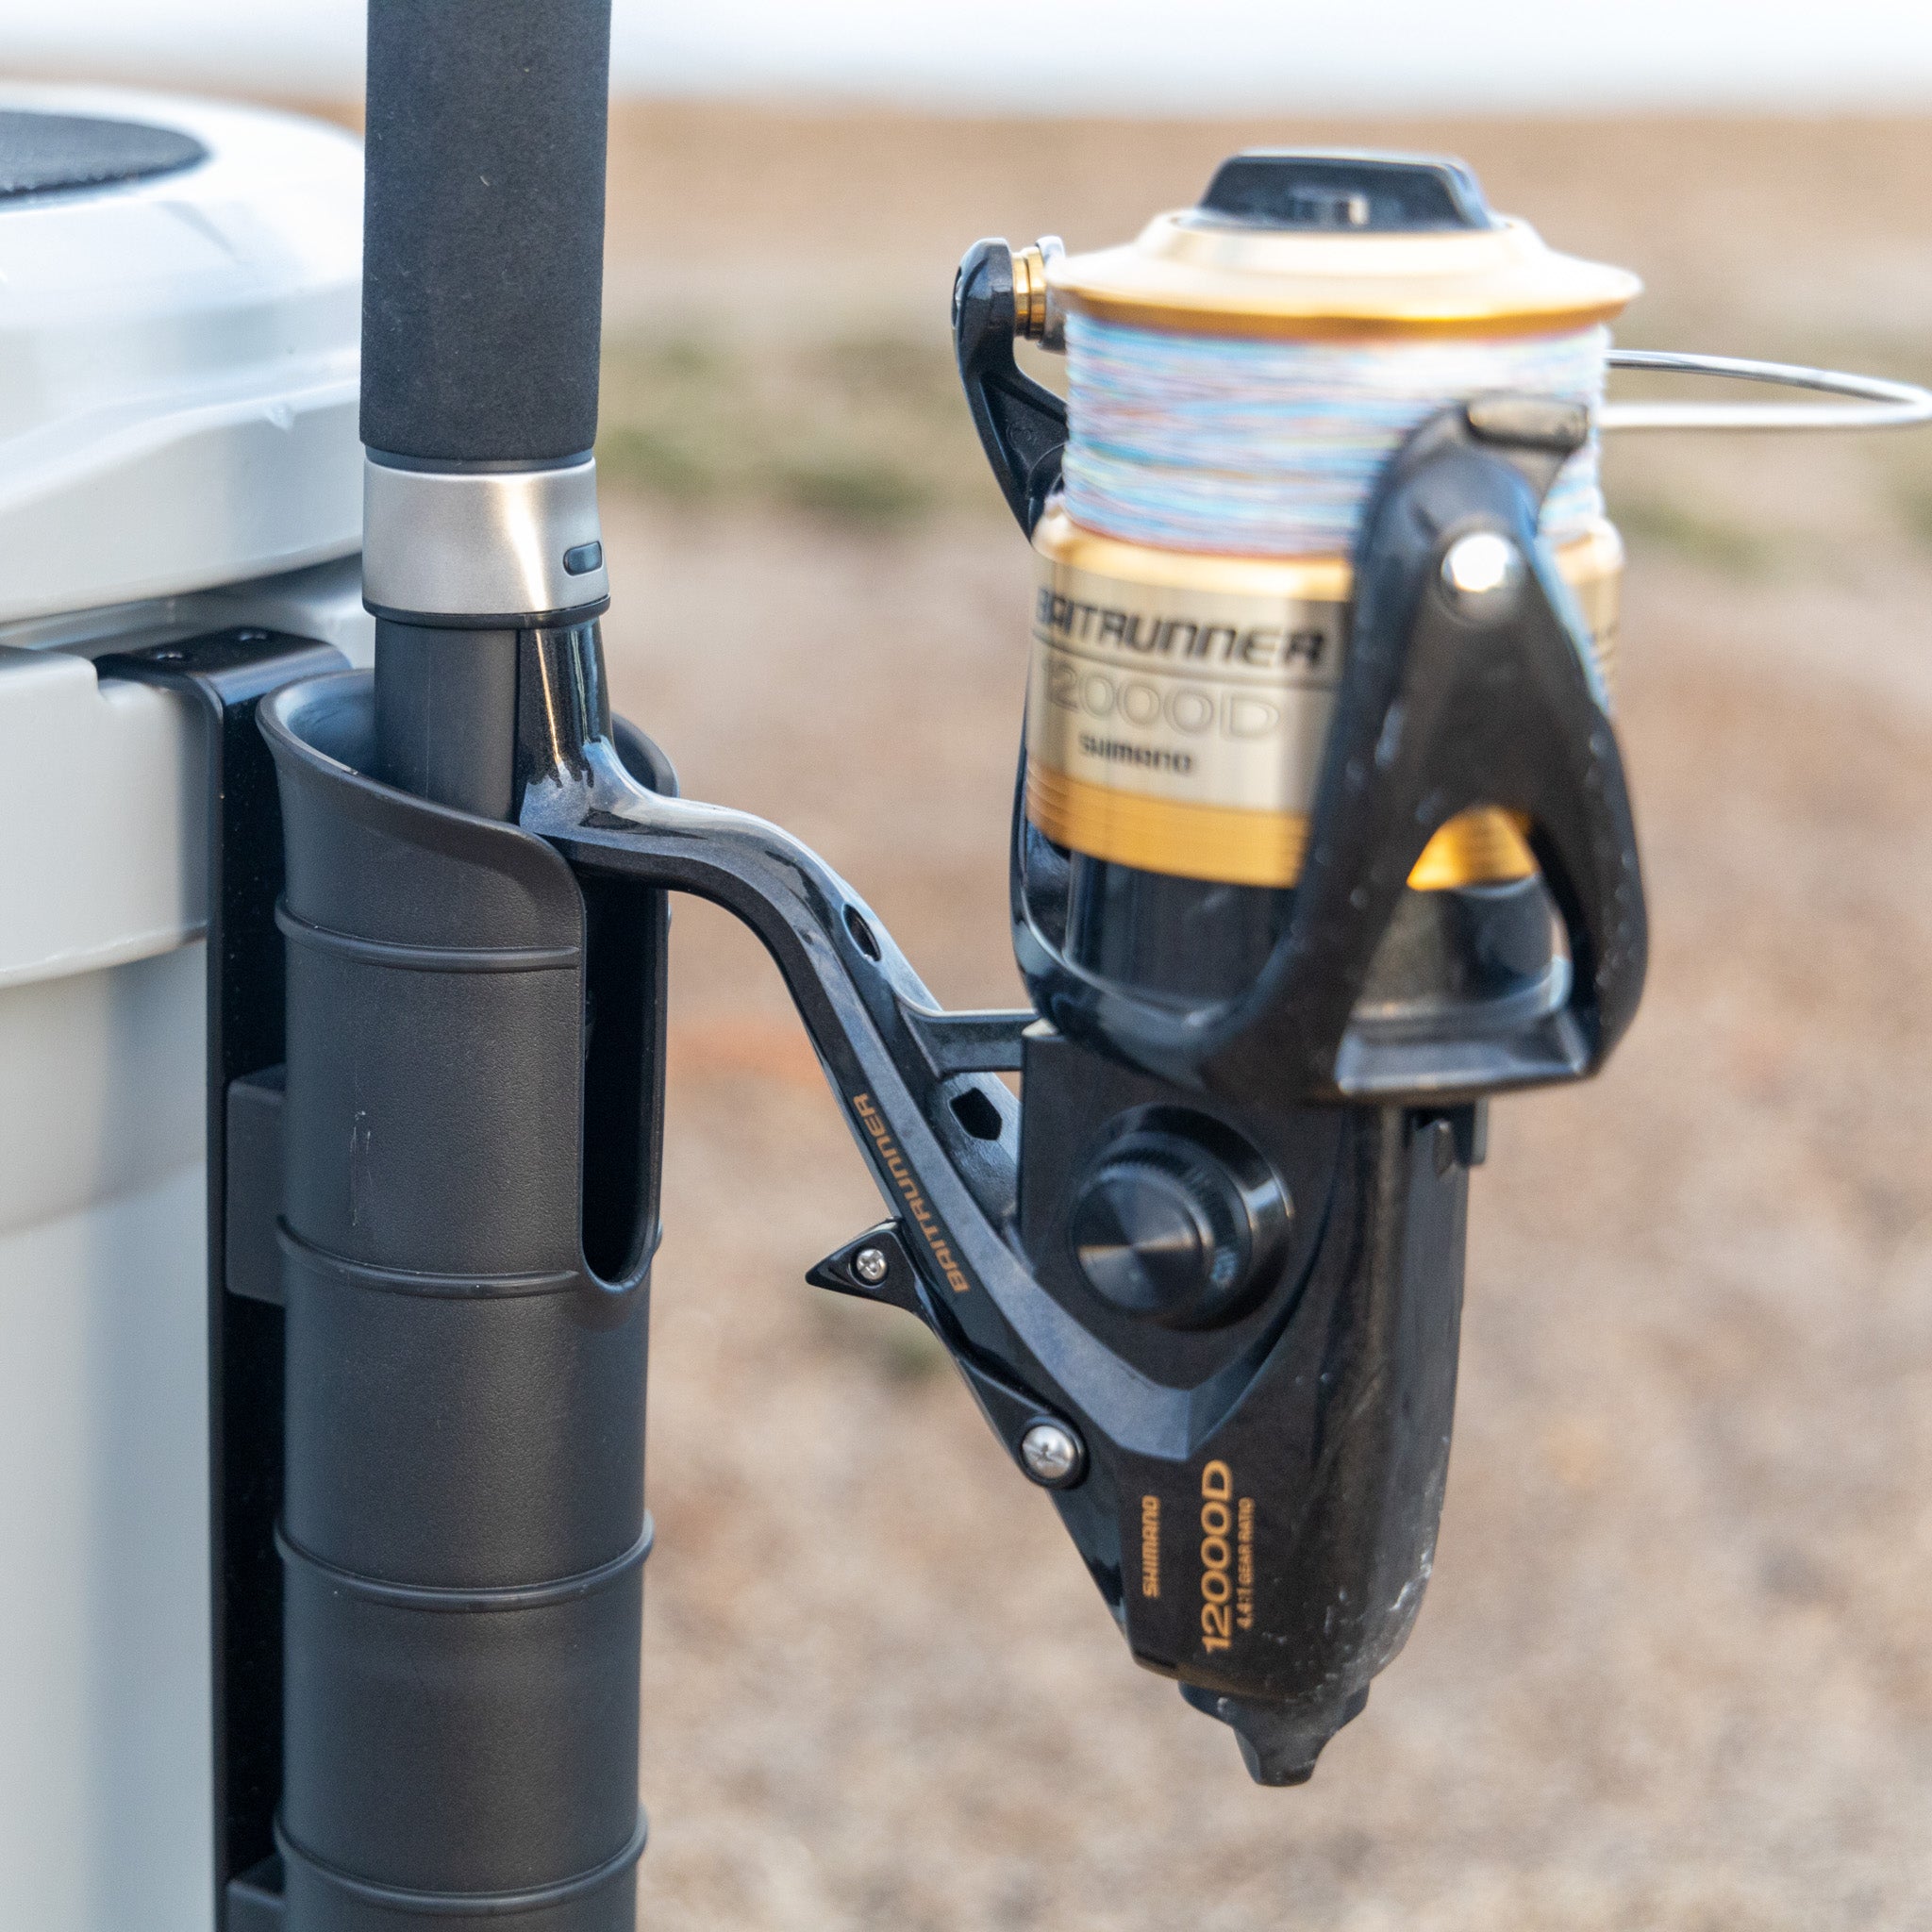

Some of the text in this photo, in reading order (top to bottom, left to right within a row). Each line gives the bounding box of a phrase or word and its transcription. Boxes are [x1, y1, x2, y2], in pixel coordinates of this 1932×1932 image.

[853, 1092, 971, 1292] BAITRUNNER
[1141, 1495, 1161, 1599] SHIMANO
[1200, 1458, 1233, 1655] 12000D
